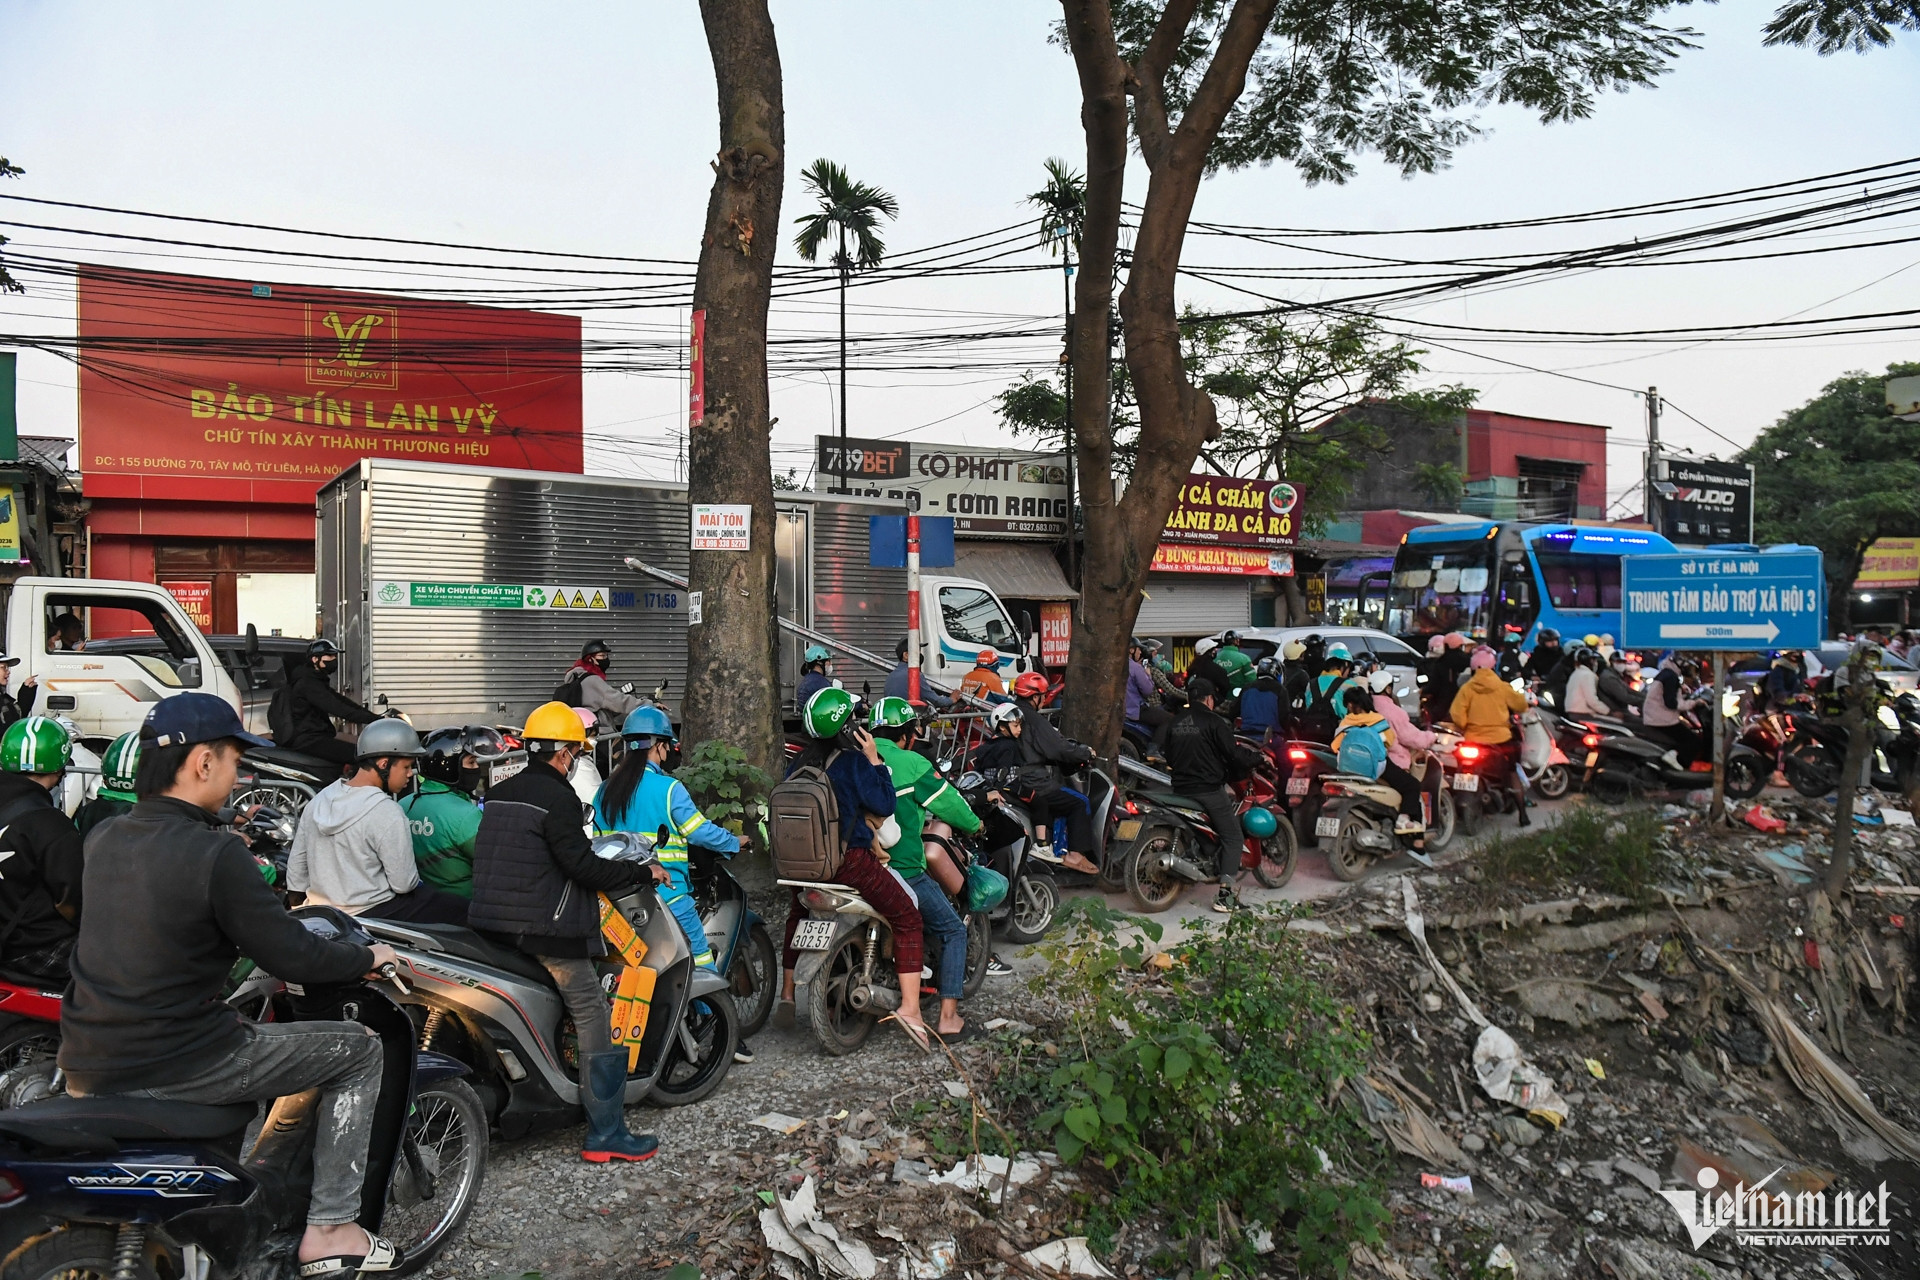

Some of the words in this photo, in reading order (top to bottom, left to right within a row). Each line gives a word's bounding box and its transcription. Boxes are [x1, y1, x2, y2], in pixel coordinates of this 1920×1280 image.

[191, 382, 274, 422] BẢO
[286, 391, 352, 427] TÍN
[365, 400, 438, 432] LAN
[450, 402, 498, 436] VỸ
[204, 428, 244, 444] CHỮ
[247, 429, 277, 445] TÍN
[281, 432, 315, 447] XÂY
[319, 432, 378, 451] THÀNH
[382, 437, 451, 455] THƯƠNG
[454, 442, 490, 457] HIỆU
[95, 455, 116, 466] ĐC:
[119, 457, 141, 467] 155
[143, 457, 187, 469] ĐƯỜNG
[189, 460, 206, 471] 70,
[208, 458, 229, 471] TÂY
[273, 463, 302, 475] LIÊM,
[304, 462, 321, 475] HÀ
[918, 450, 950, 478] CÔ
[1189, 481, 1212, 505] CÁ
[1216, 482, 1265, 509] CHẤM
[947, 492, 998, 515] CƠM
[1005, 496, 1067, 518] RANG
[700, 512, 720, 526] MÁI
[723, 512, 743, 526] TÔN
[1213, 513, 1238, 533] ĐA
[1242, 511, 1265, 535] CÁ
[1268, 513, 1292, 536] RÔ
[1199, 551, 1225, 565] KHAI
[1681, 560, 1695, 574] SỞ
[1698, 563, 1704, 574] Y
[1707, 561, 1720, 573] TẾ
[1722, 560, 1737, 573] HÀ
[1740, 562, 1759, 575] NỘI
[428, 584, 445, 595] VẬN
[447, 583, 479, 594] CHUYỂN
[481, 586, 502, 595] CHẤT
[504, 587, 522, 595] THẢI
[180, 602, 201, 613] HAI
[611, 592, 634, 607] 30M
[644, 593, 677, 608] 171.58
[1629, 591, 1669, 612] TRUNG
[1672, 587, 1699, 612] TÂM
[1702, 583, 1728, 612] BẢO
[1731, 589, 1756, 617] TRỢ
[1759, 586, 1778, 612] XÃ
[1781, 585, 1804, 617] HỘI
[1807, 590, 1815, 612] 3
[1043, 615, 1068, 638] PHỞ
[1706, 627, 1733, 636] 500m
[831, 703, 847, 722] Grab
[409, 816, 434, 836] rab
[803, 922, 831, 935] 15-G1
[794, 935, 830, 948] 302.57
